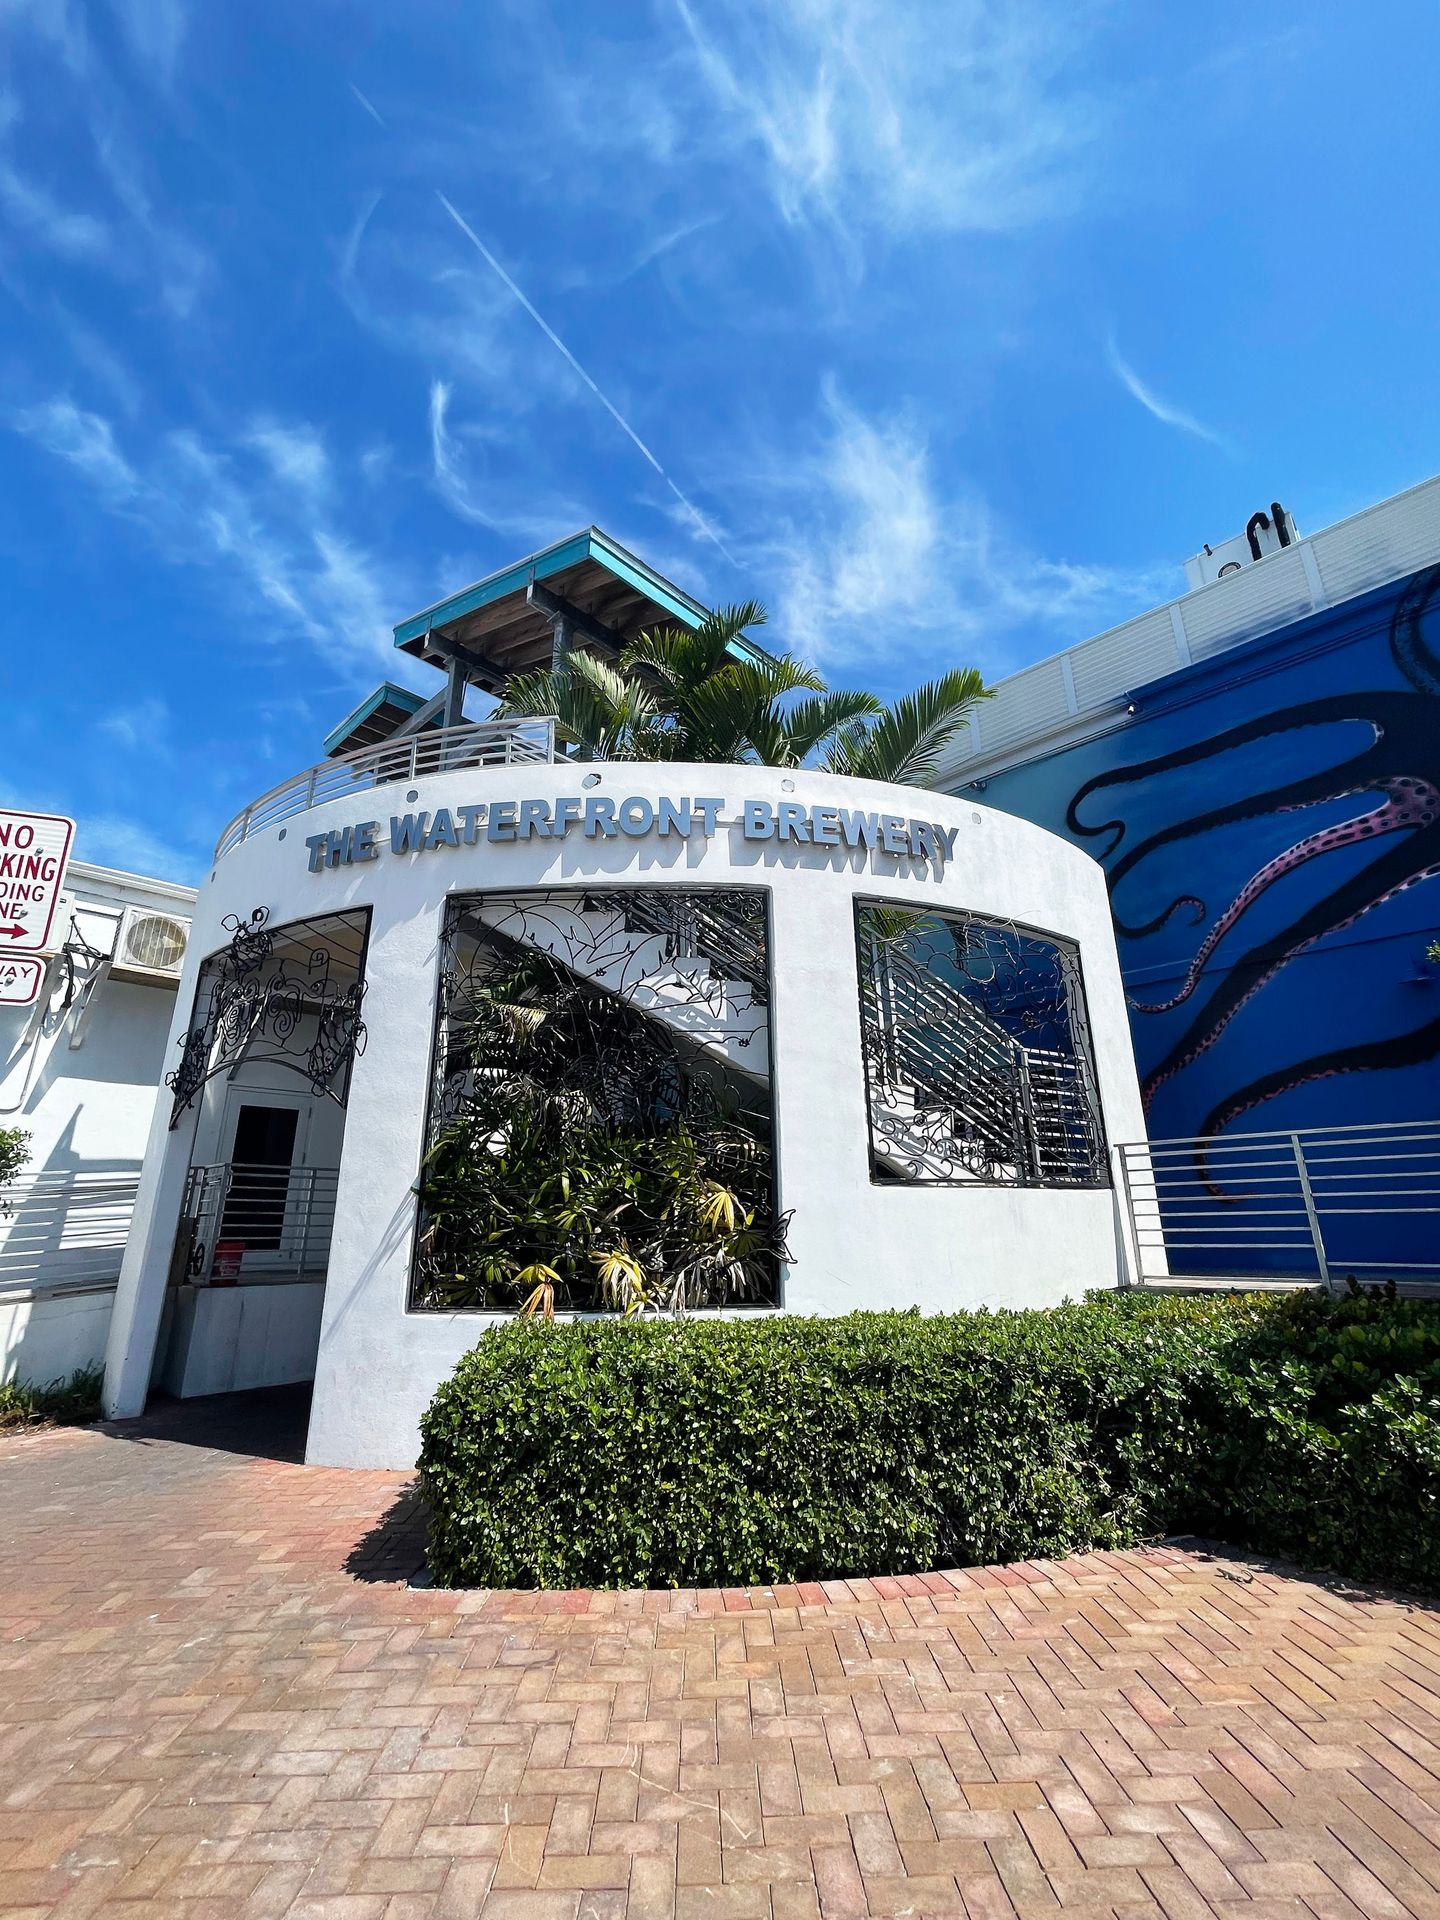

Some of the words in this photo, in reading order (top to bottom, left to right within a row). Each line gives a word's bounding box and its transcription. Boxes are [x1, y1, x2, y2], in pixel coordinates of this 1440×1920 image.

[0, 824, 34, 849] NO
[305, 821, 380, 873] THE
[390, 797, 725, 855] WATERFRONT
[744, 800, 959, 862] BREWERY
[0, 853, 57, 882] KING
[0, 966, 34, 978] AY
